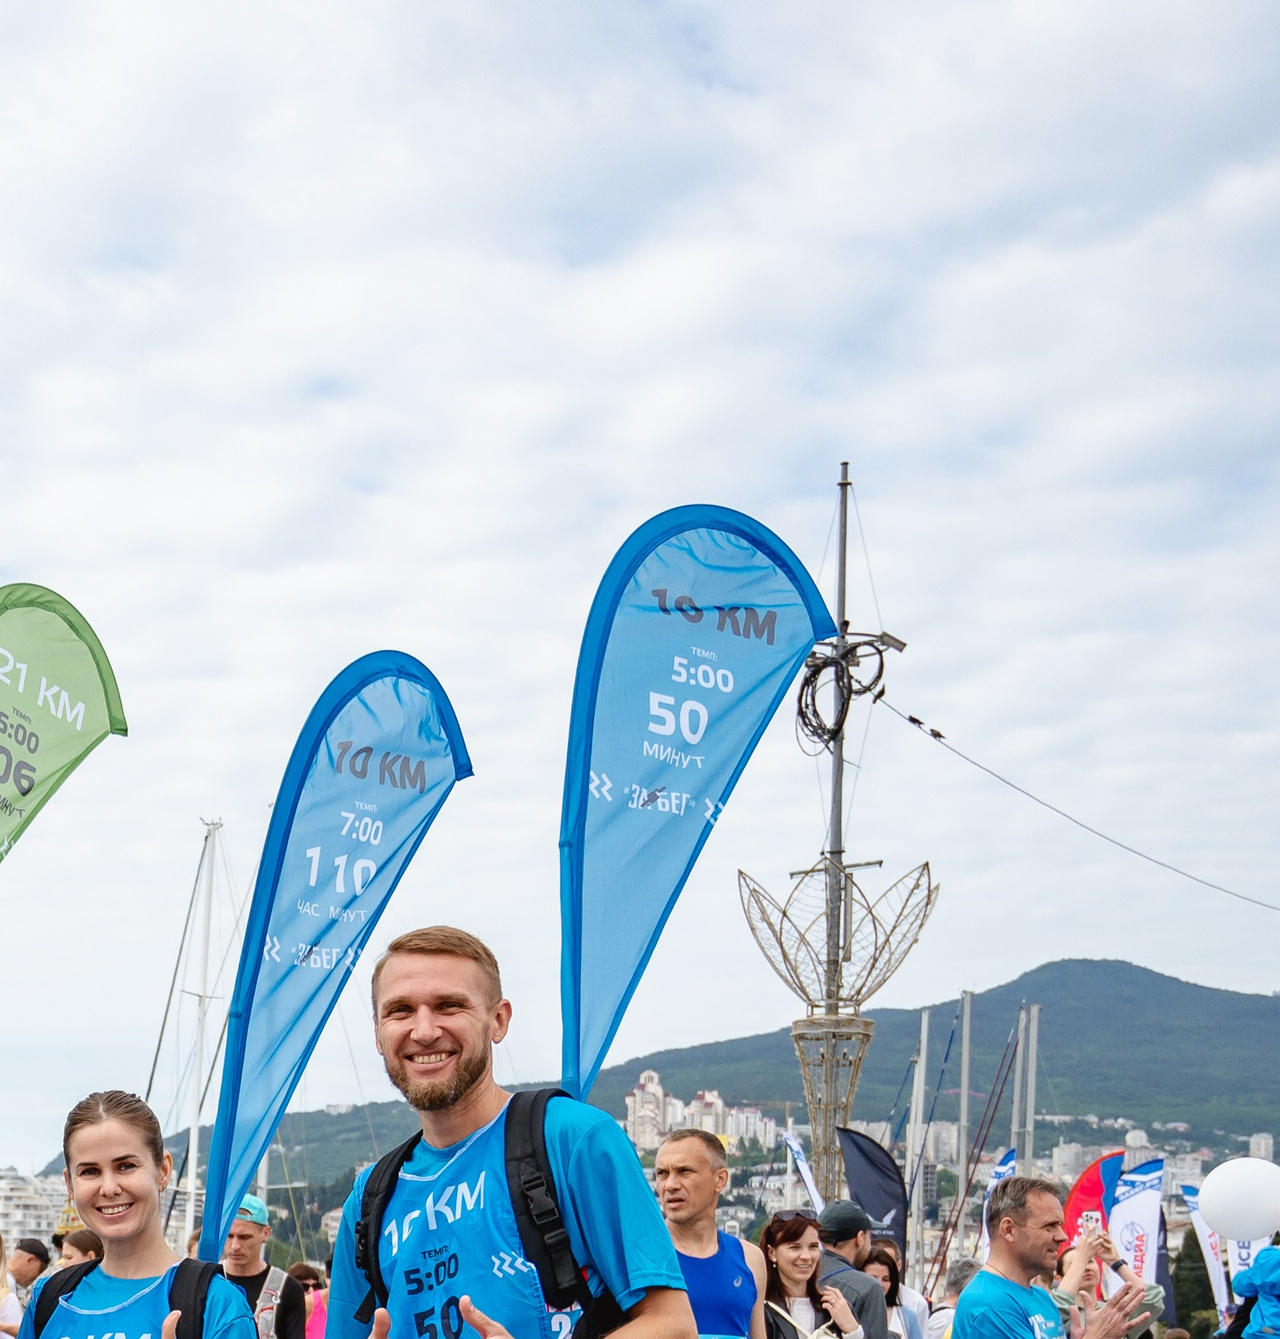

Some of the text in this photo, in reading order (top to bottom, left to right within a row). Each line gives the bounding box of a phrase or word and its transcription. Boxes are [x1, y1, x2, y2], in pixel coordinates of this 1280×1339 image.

[651, 588, 777, 646] 10 KM
[671, 656, 734, 693] 5:00
[691, 646, 718, 662] ТЕМП:
[37, 676, 86, 731] KM
[648, 691, 708, 745] 50
[336, 741, 426, 794] 10 KM
[643, 740, 705, 768] МИНУТ
[340, 811, 383, 846] 7:00
[306, 846, 377, 896] 1 10
[297, 899, 320, 917] ЧАС
[425, 1171, 486, 1231] KM
[421, 1245, 449, 1260] ТЕМП:
[404, 1253, 459, 1296] 5:00
